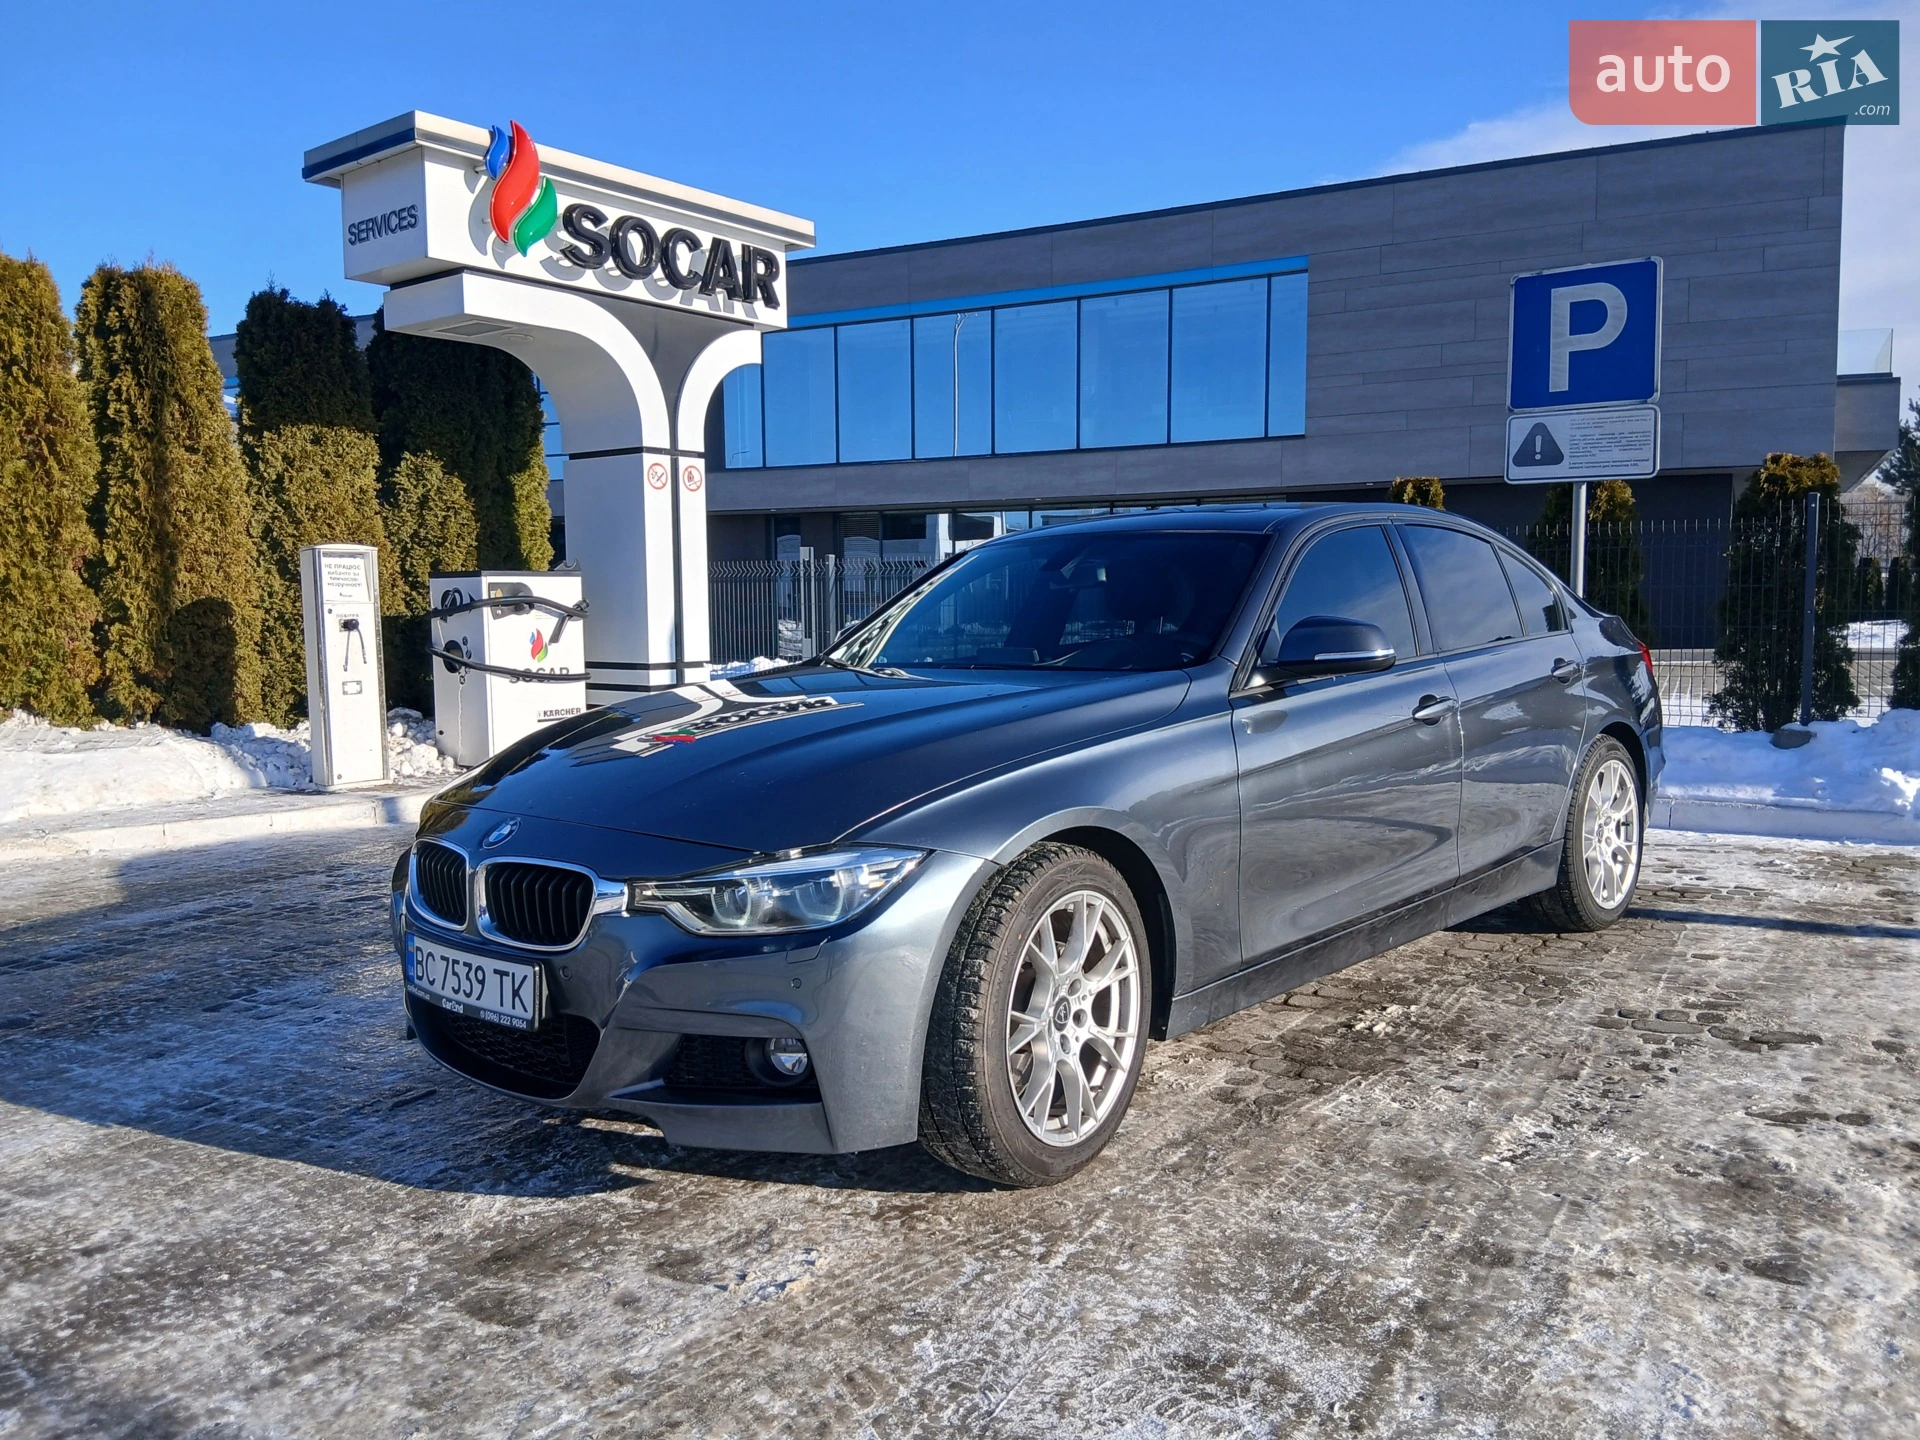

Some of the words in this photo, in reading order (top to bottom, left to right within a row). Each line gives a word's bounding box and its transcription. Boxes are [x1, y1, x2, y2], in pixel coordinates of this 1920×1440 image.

[348, 204, 419, 246] SERVICES
[560, 202, 780, 309] SOCAR
[1549, 282, 1628, 392] P
[440, 955, 486, 1001] 7539
[500, 1015, 511, 1025] 222
